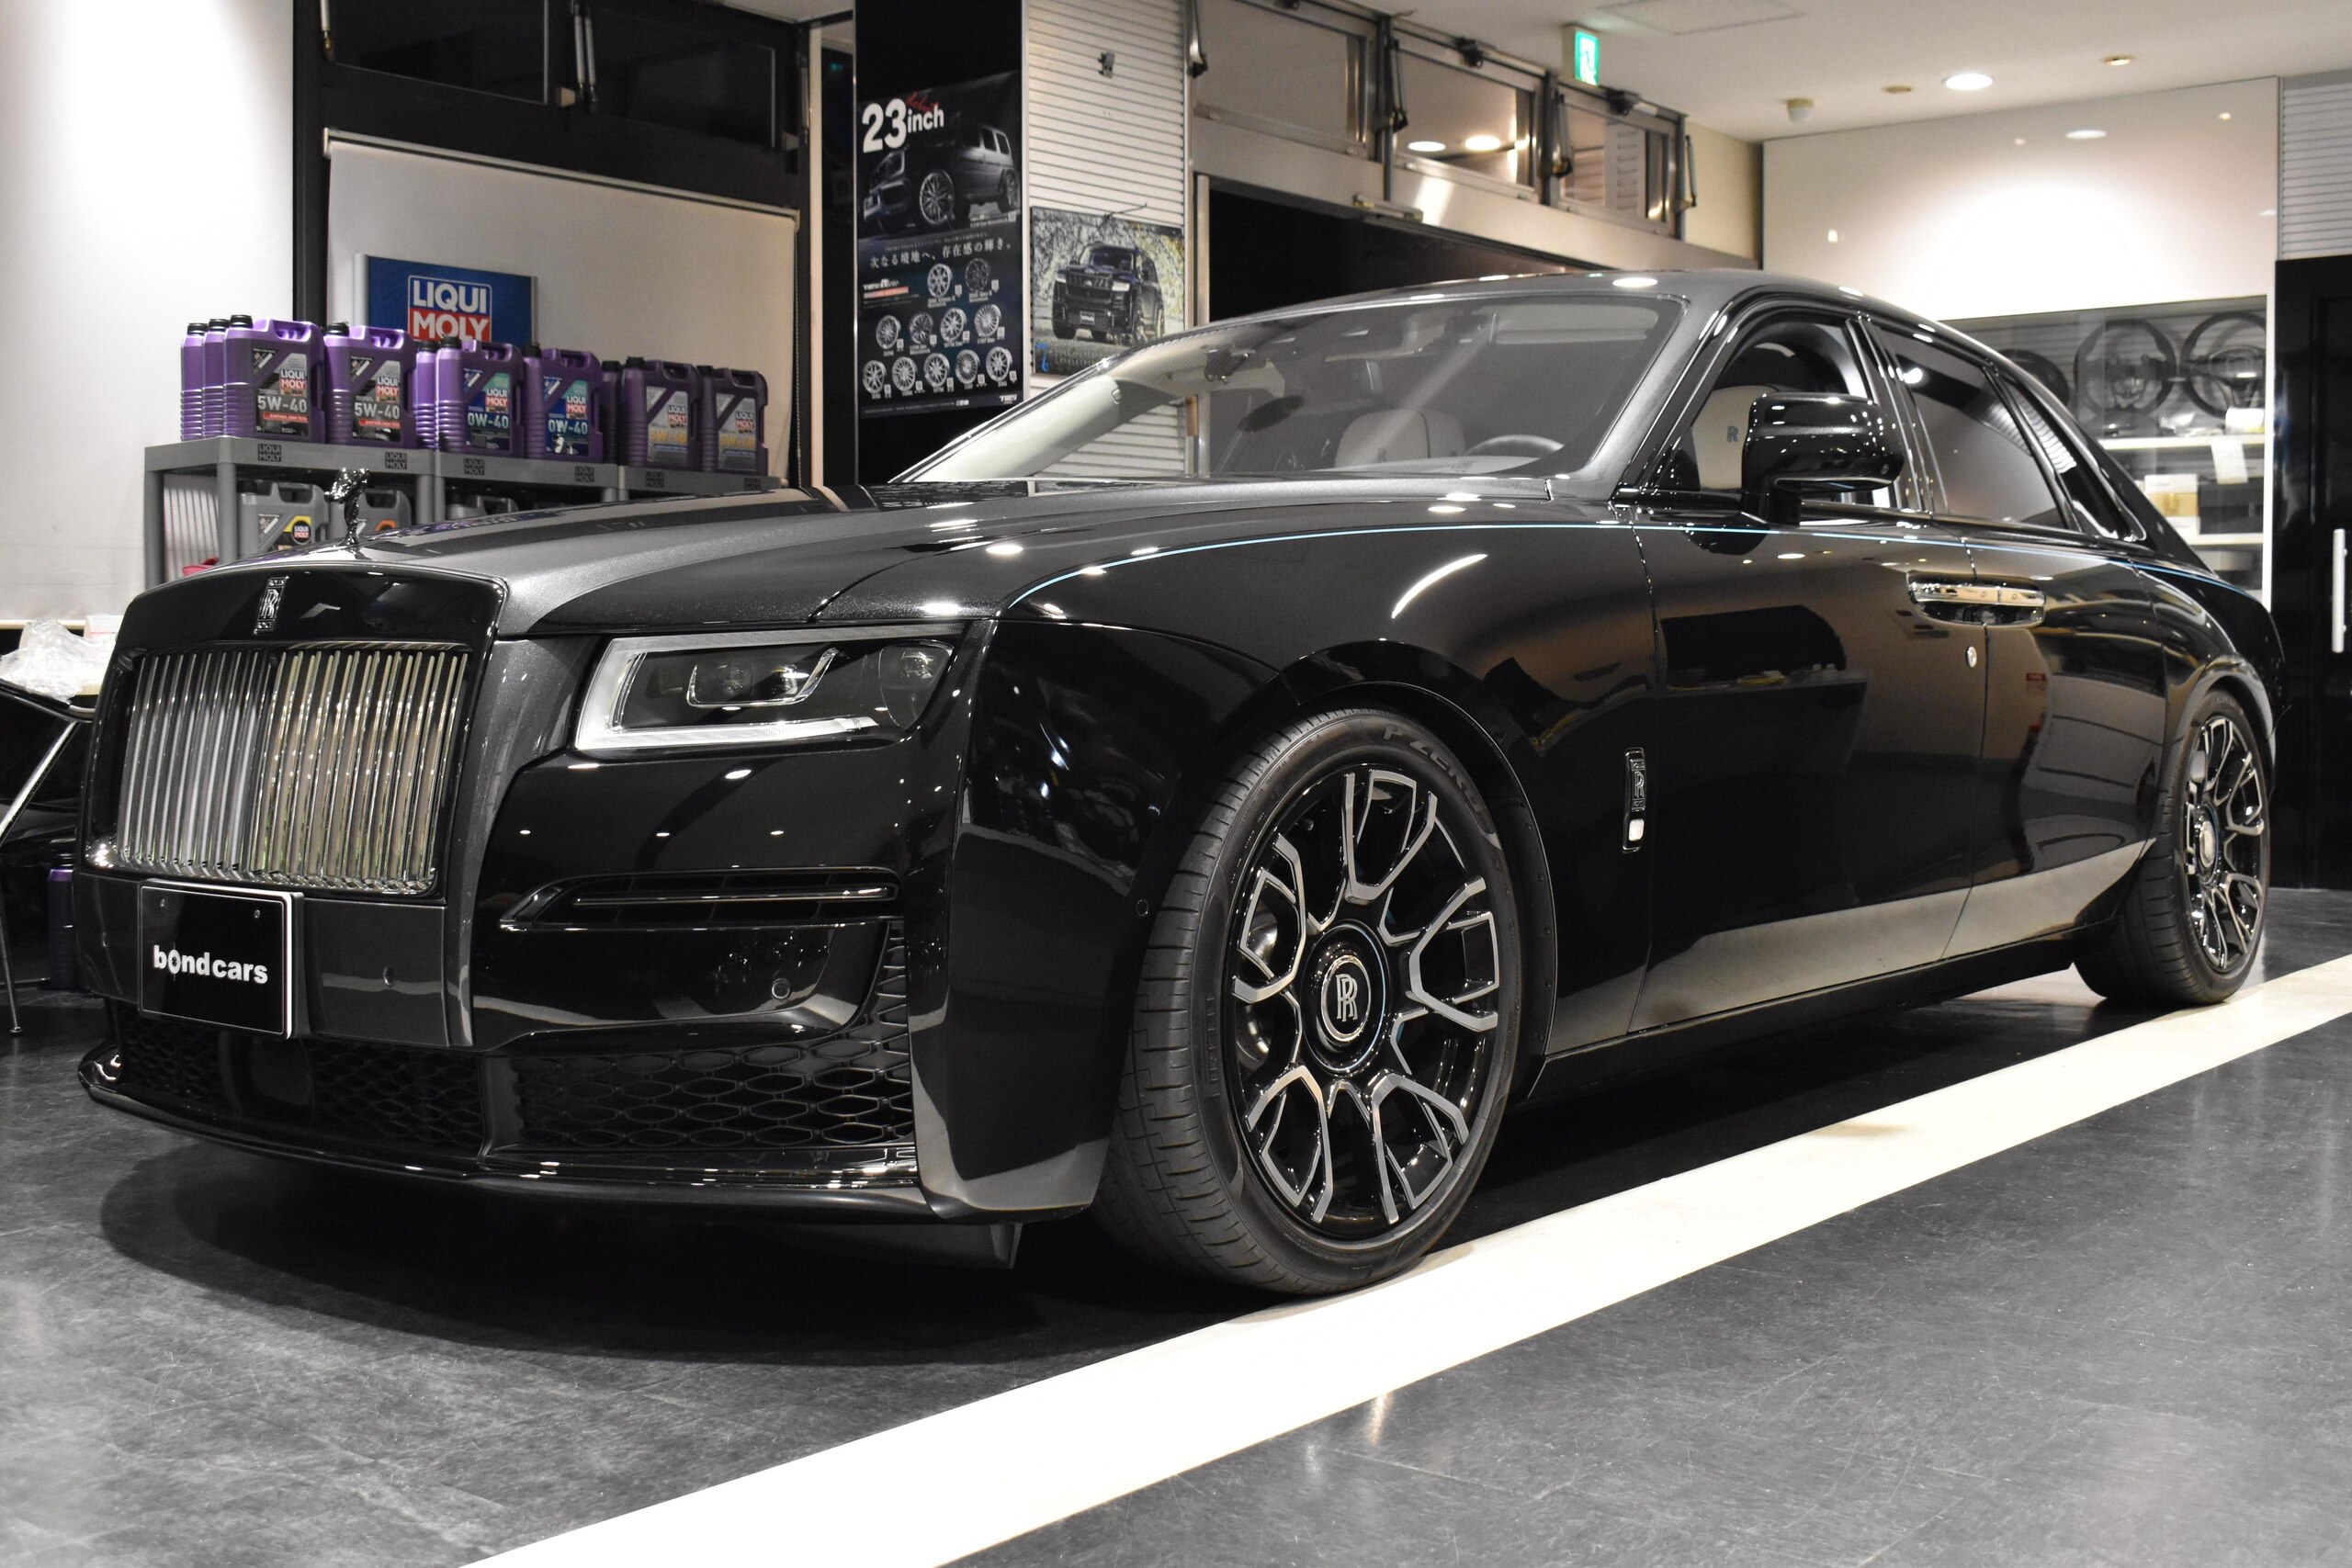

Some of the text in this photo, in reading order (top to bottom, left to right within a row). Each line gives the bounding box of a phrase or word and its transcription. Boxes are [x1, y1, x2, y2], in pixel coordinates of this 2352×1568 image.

[413, 279, 487, 314] LIQUI
[413, 310, 490, 343] MOLY
[280, 369, 305, 380] LIQUI
[280, 379, 306, 389] MOLY
[378, 377, 399, 387] LIQUI
[377, 386, 399, 397] MOLY
[487, 389, 507, 397] LIQUI
[257, 395, 308, 413] 5W-40
[486, 397, 508, 407] MOLY
[567, 396, 587, 404] LIQUI
[354, 402, 400, 420] 5W-40
[567, 404, 587, 413] MOLY
[467, 412, 509, 429] 0W-40
[548, 420, 588, 434] 0W-40
